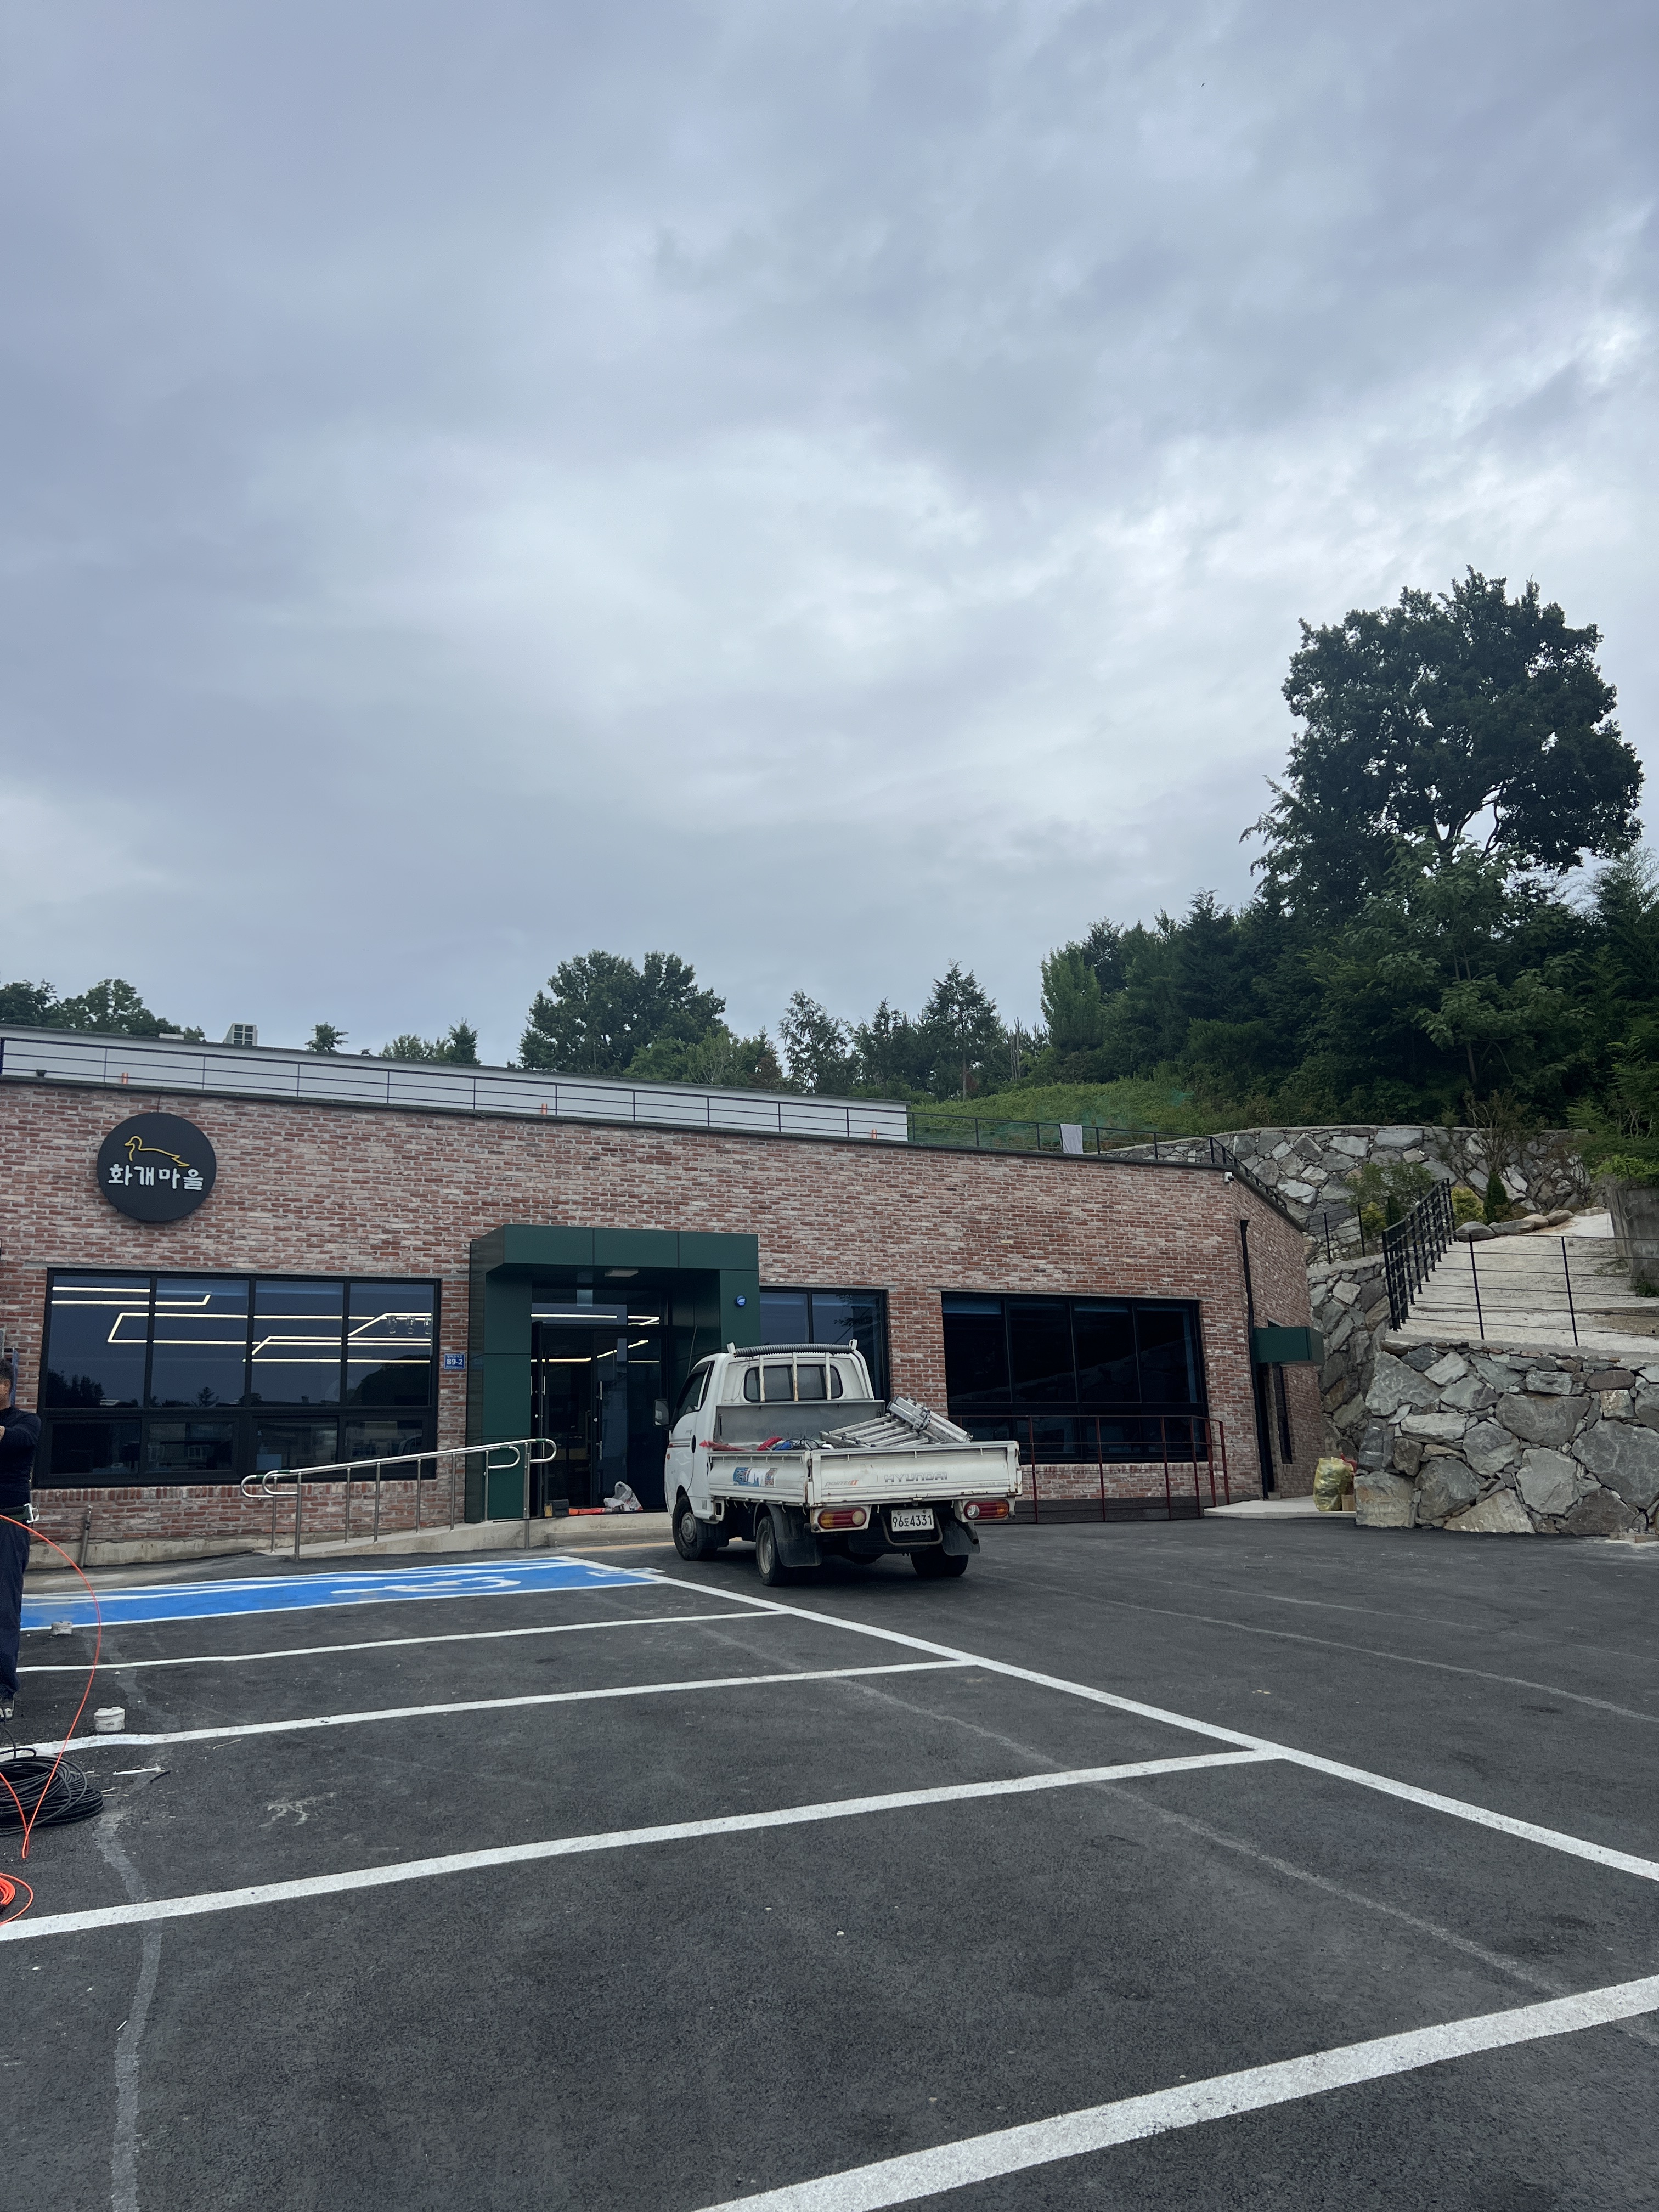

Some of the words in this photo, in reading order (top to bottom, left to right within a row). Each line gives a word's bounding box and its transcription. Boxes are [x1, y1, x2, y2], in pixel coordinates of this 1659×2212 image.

[108, 1164, 204, 1190] 화개마을
[884, 1472, 947, 1482] HYUNDAI
[893, 1515, 932, 1527] 96도4331
